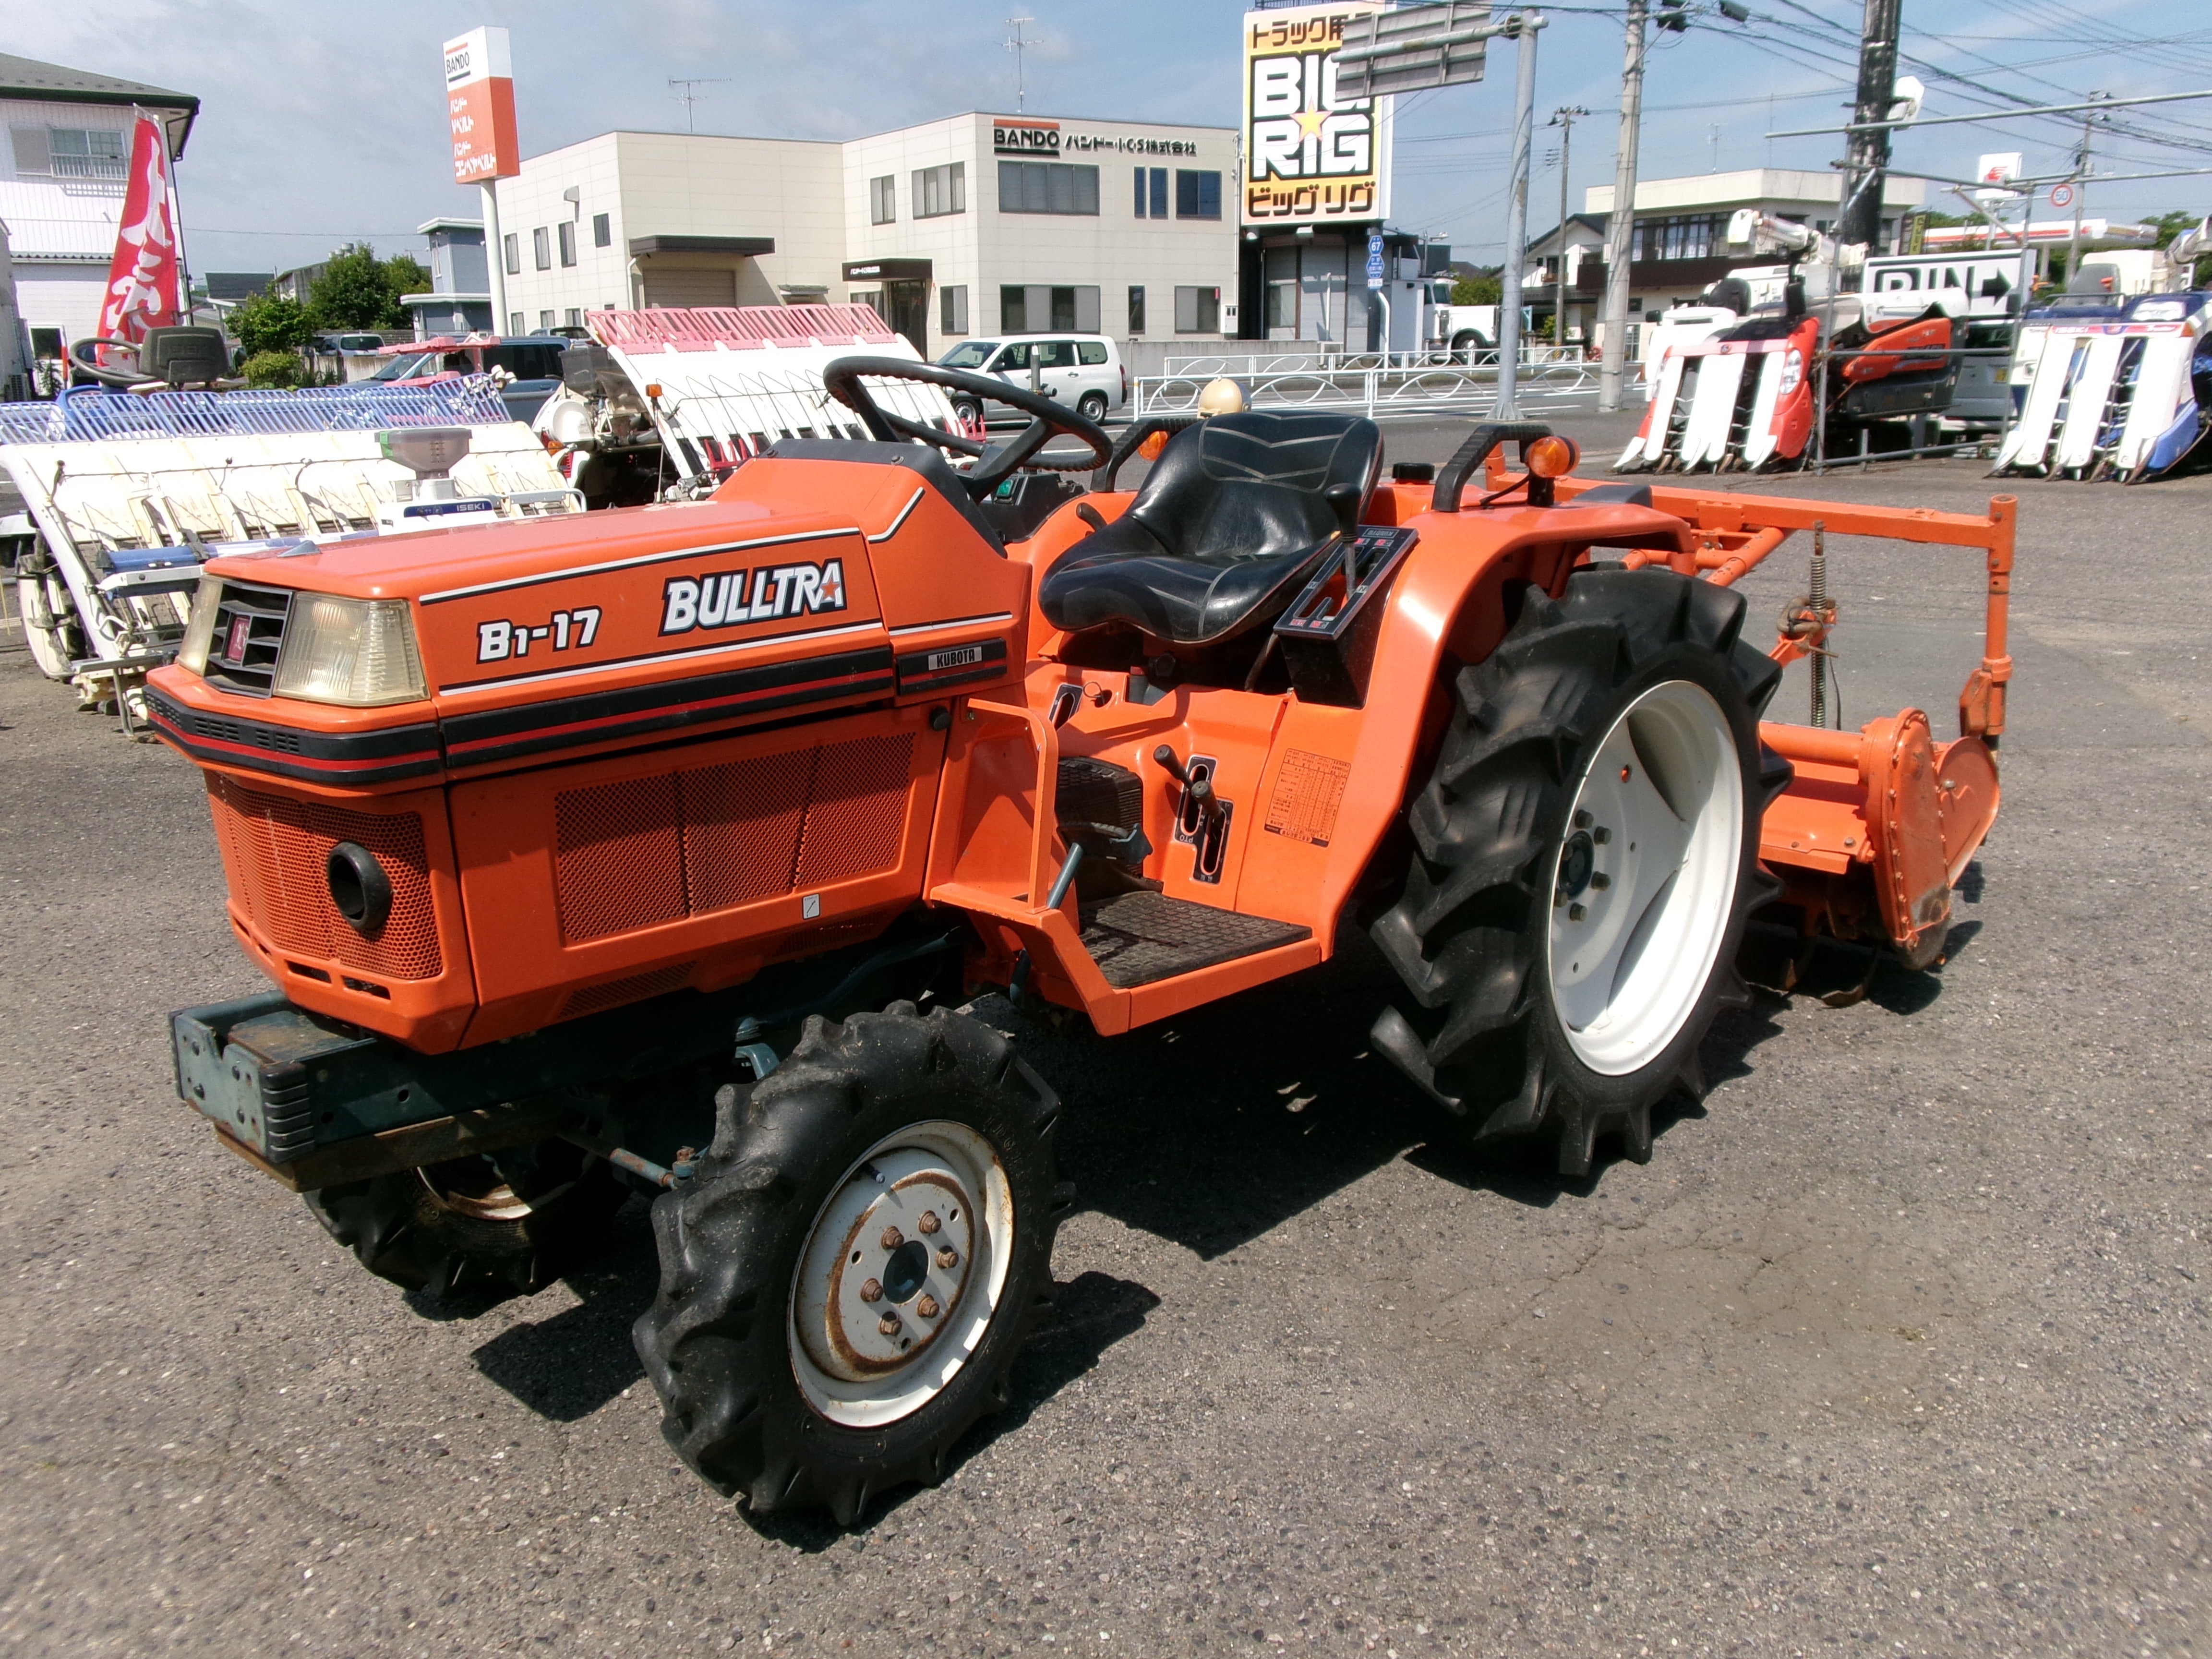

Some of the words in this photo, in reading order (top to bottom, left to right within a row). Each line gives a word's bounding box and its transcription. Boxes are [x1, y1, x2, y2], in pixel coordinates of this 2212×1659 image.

[1253, 12, 1372, 48] トラック用
[446, 51, 469, 74] BANDO
[994, 128, 1060, 147] BANDO
[1254, 114, 1370, 177] RIG
[1371, 241, 1381, 251] 67
[457, 503, 485, 512] ISEKI
[662, 560, 843, 633] BULLTRA
[479, 608, 601, 661] B1-17
[936, 649, 975, 668] KUBOTA
[1179, 835, 1194, 843] PTO
